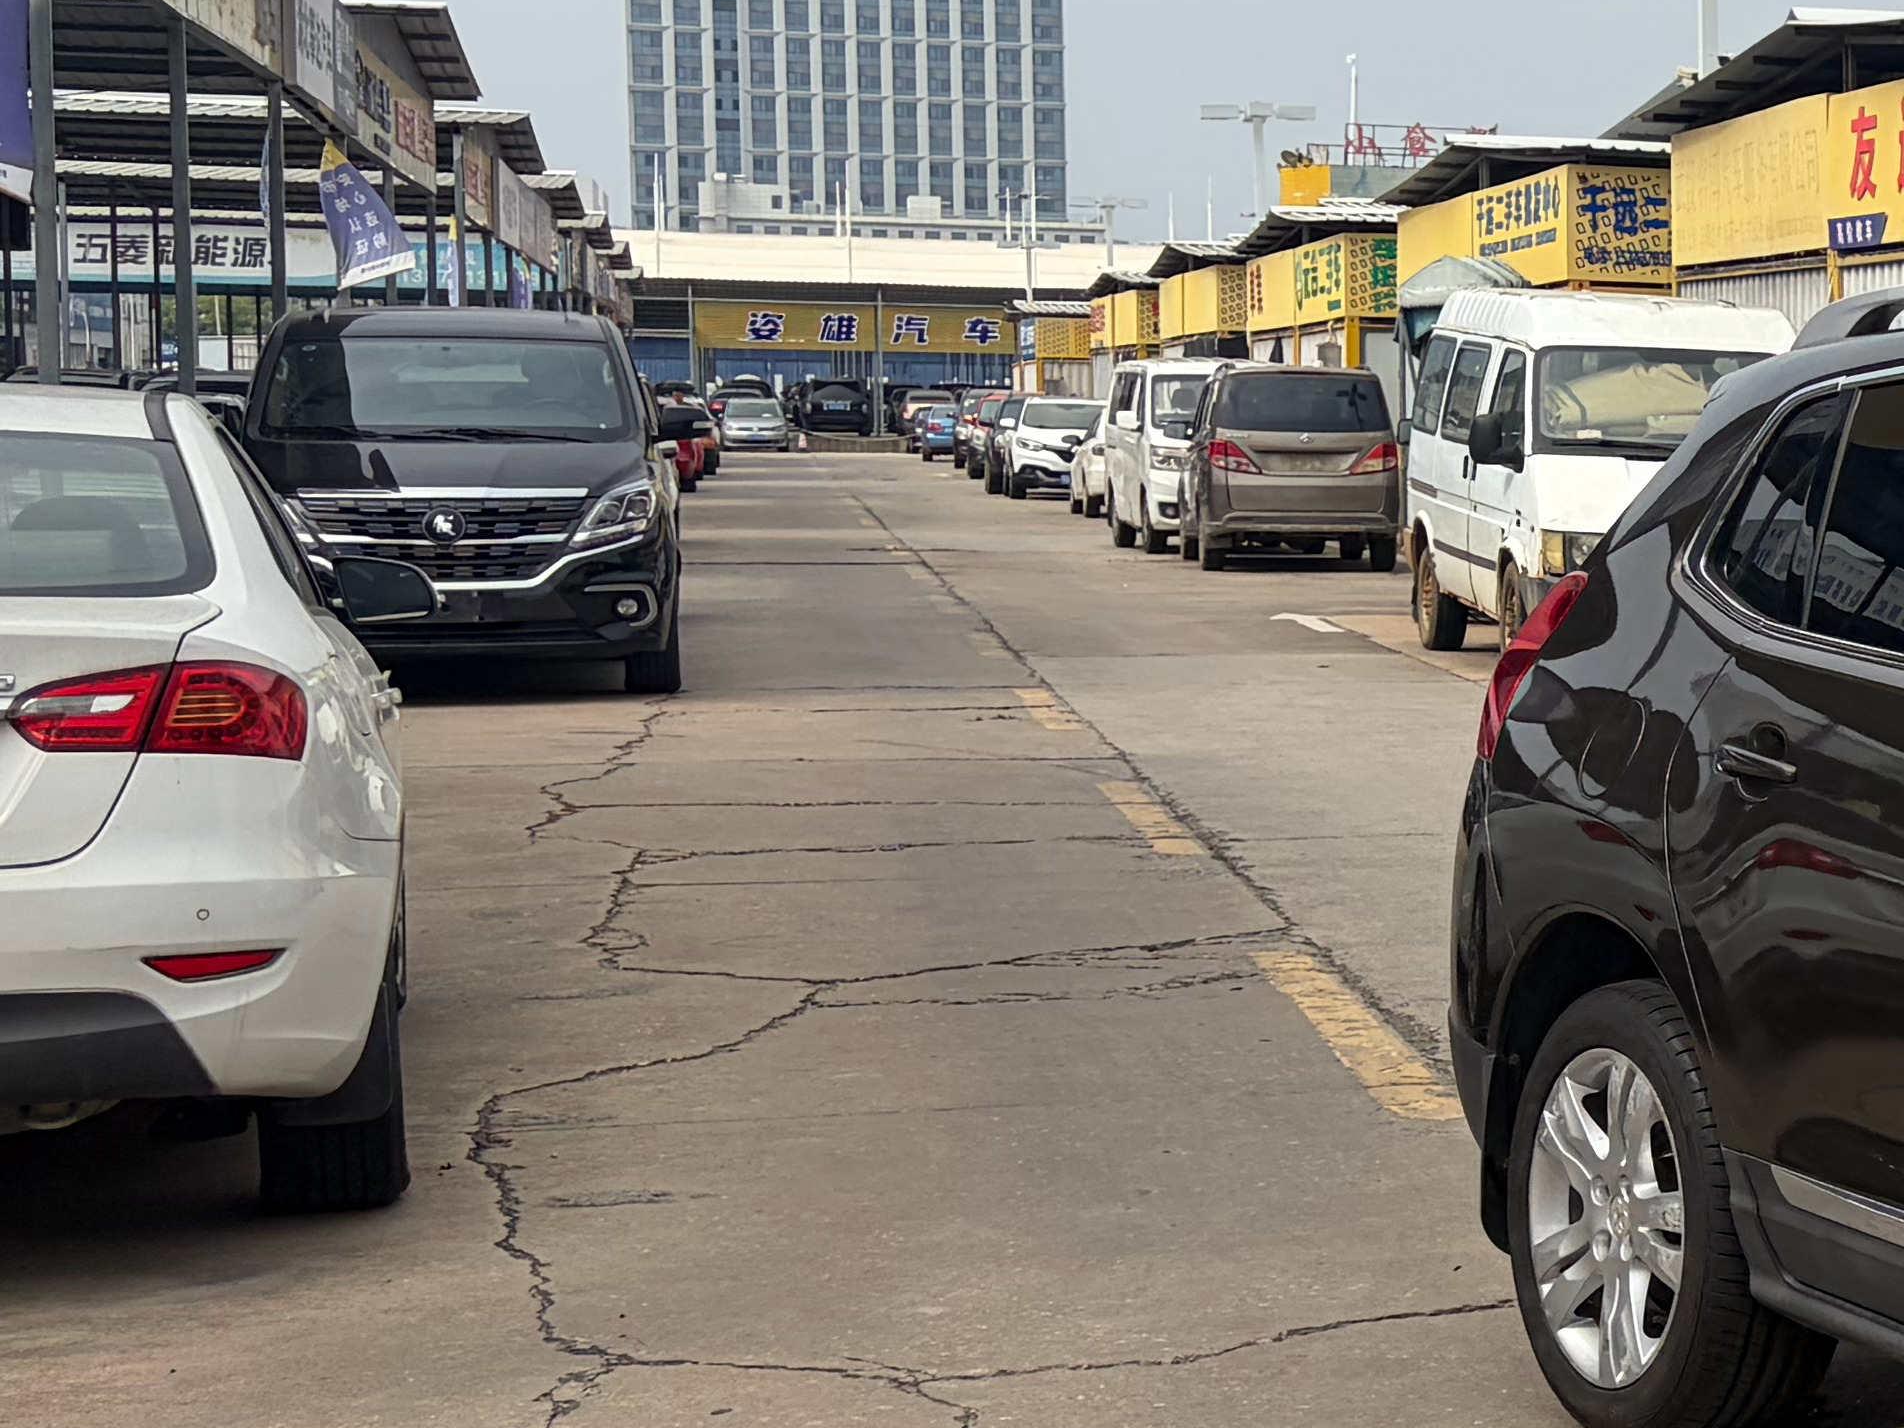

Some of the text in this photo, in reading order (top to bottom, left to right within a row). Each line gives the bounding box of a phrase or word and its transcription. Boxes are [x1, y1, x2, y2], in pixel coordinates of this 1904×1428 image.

[73, 232, 273, 269] 五菱能源
[745, 310, 1002, 346] 姿雄汽车
